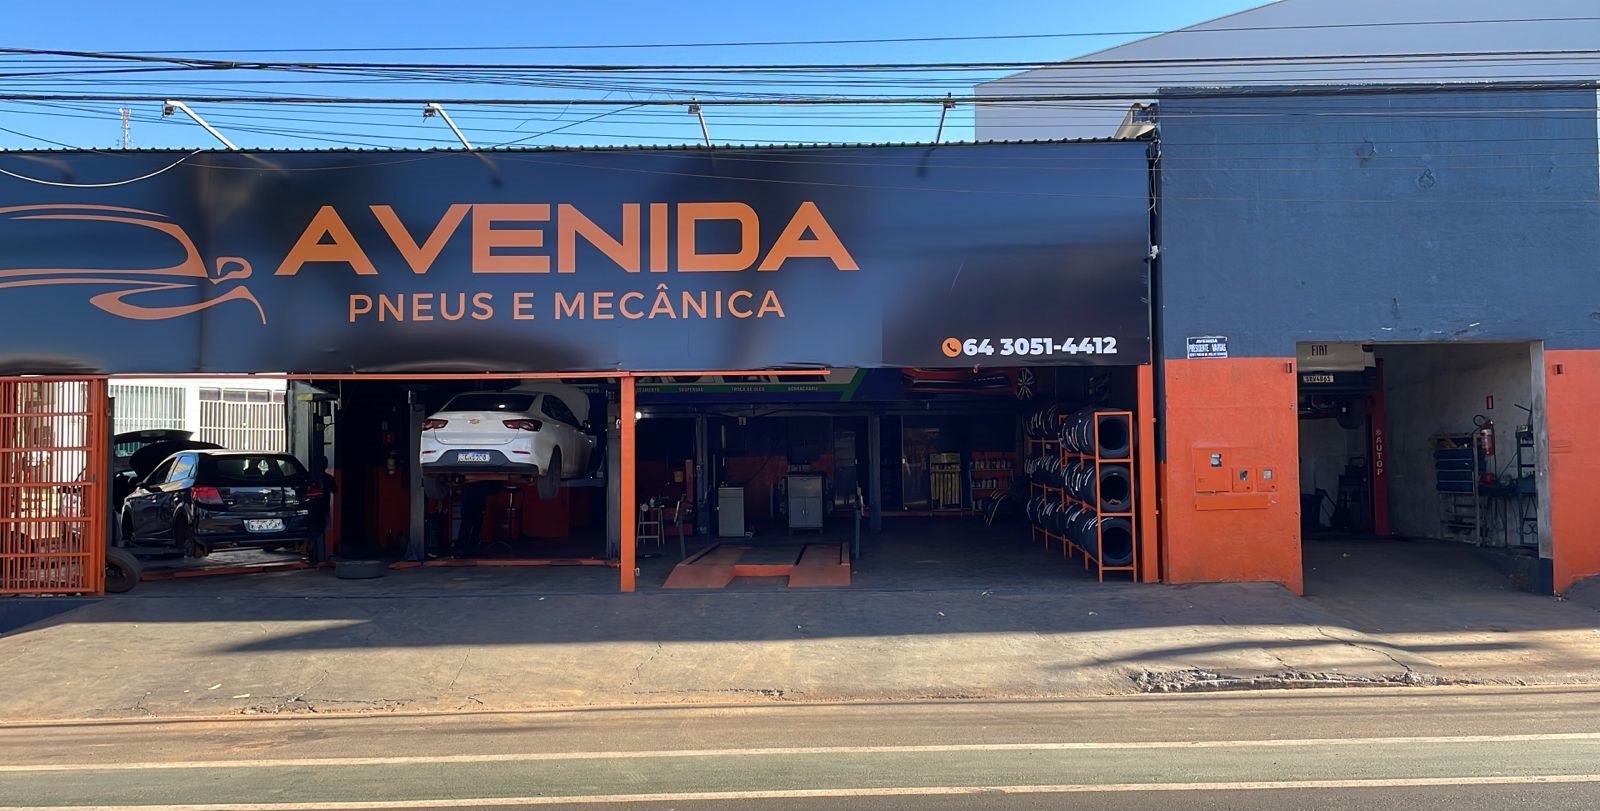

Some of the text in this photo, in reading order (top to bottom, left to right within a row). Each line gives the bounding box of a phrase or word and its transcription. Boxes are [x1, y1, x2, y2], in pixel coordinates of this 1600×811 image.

[276, 200, 858, 276] AVENIDA
[349, 283, 785, 321] PNEUS E MECÂNICA
[962, 336, 1118, 356] 64 3051-4412
[1311, 344, 1328, 356] FIAT
